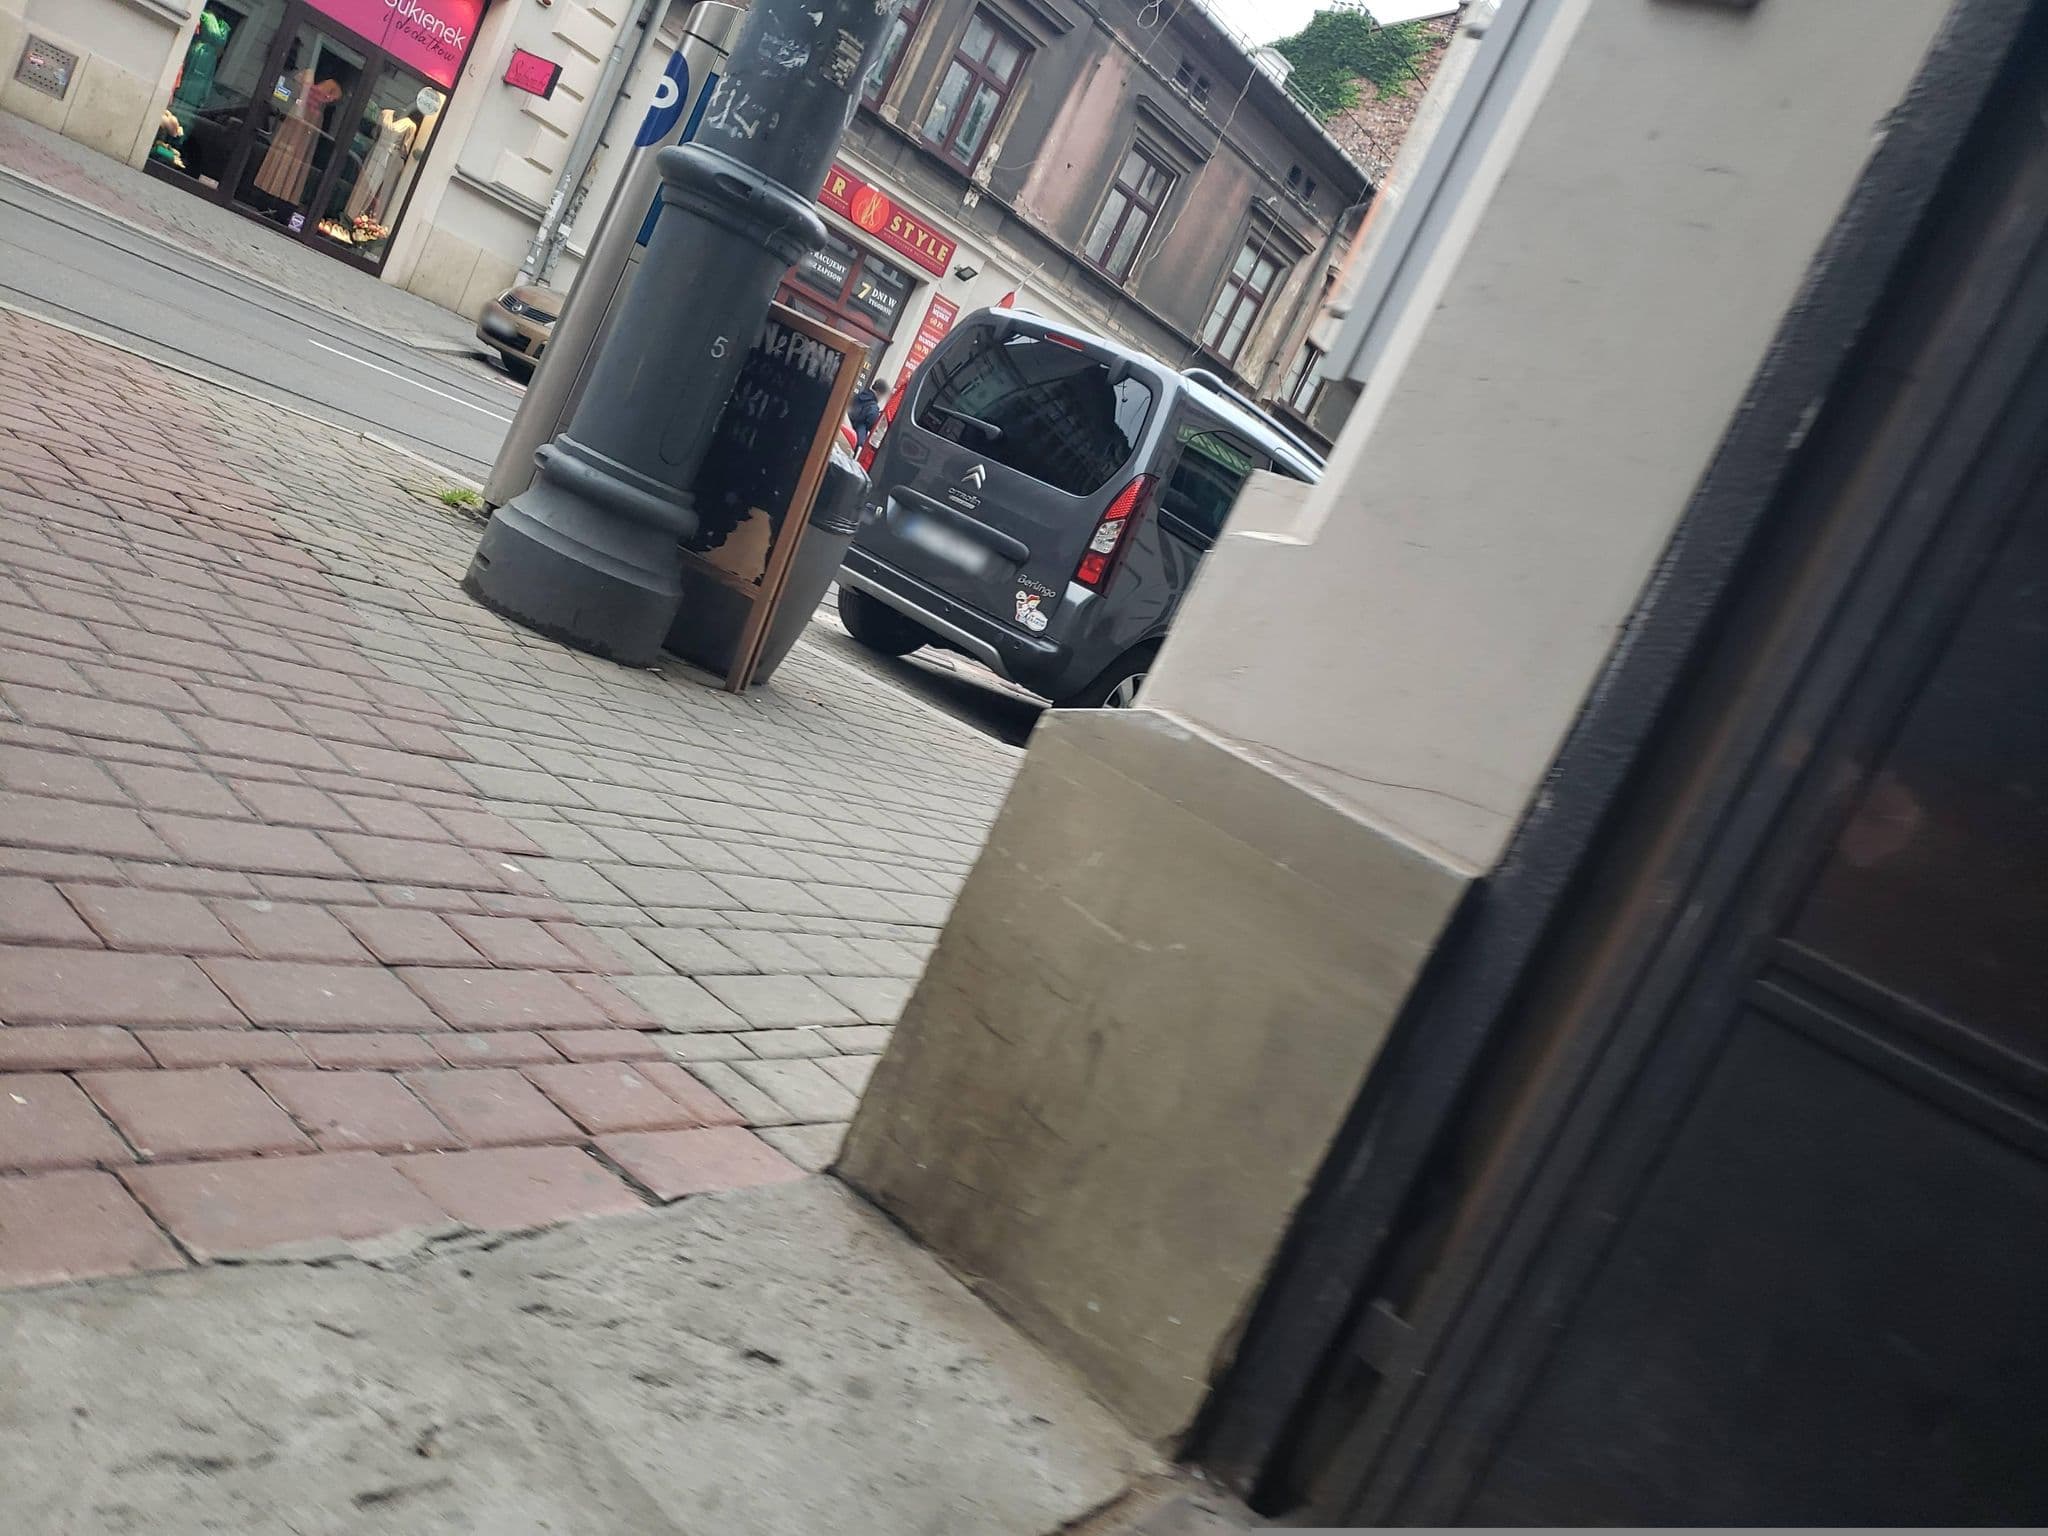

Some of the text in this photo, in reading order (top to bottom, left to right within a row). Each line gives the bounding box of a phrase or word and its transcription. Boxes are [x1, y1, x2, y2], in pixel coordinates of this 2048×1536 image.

[890, 215, 949, 263] STYLE
[809, 250, 847, 274] RACUJEMY
[857, 281, 898, 308] 7 DNI W
[710, 335, 729, 358] 5
[1017, 573, 1057, 599] Berlingo
